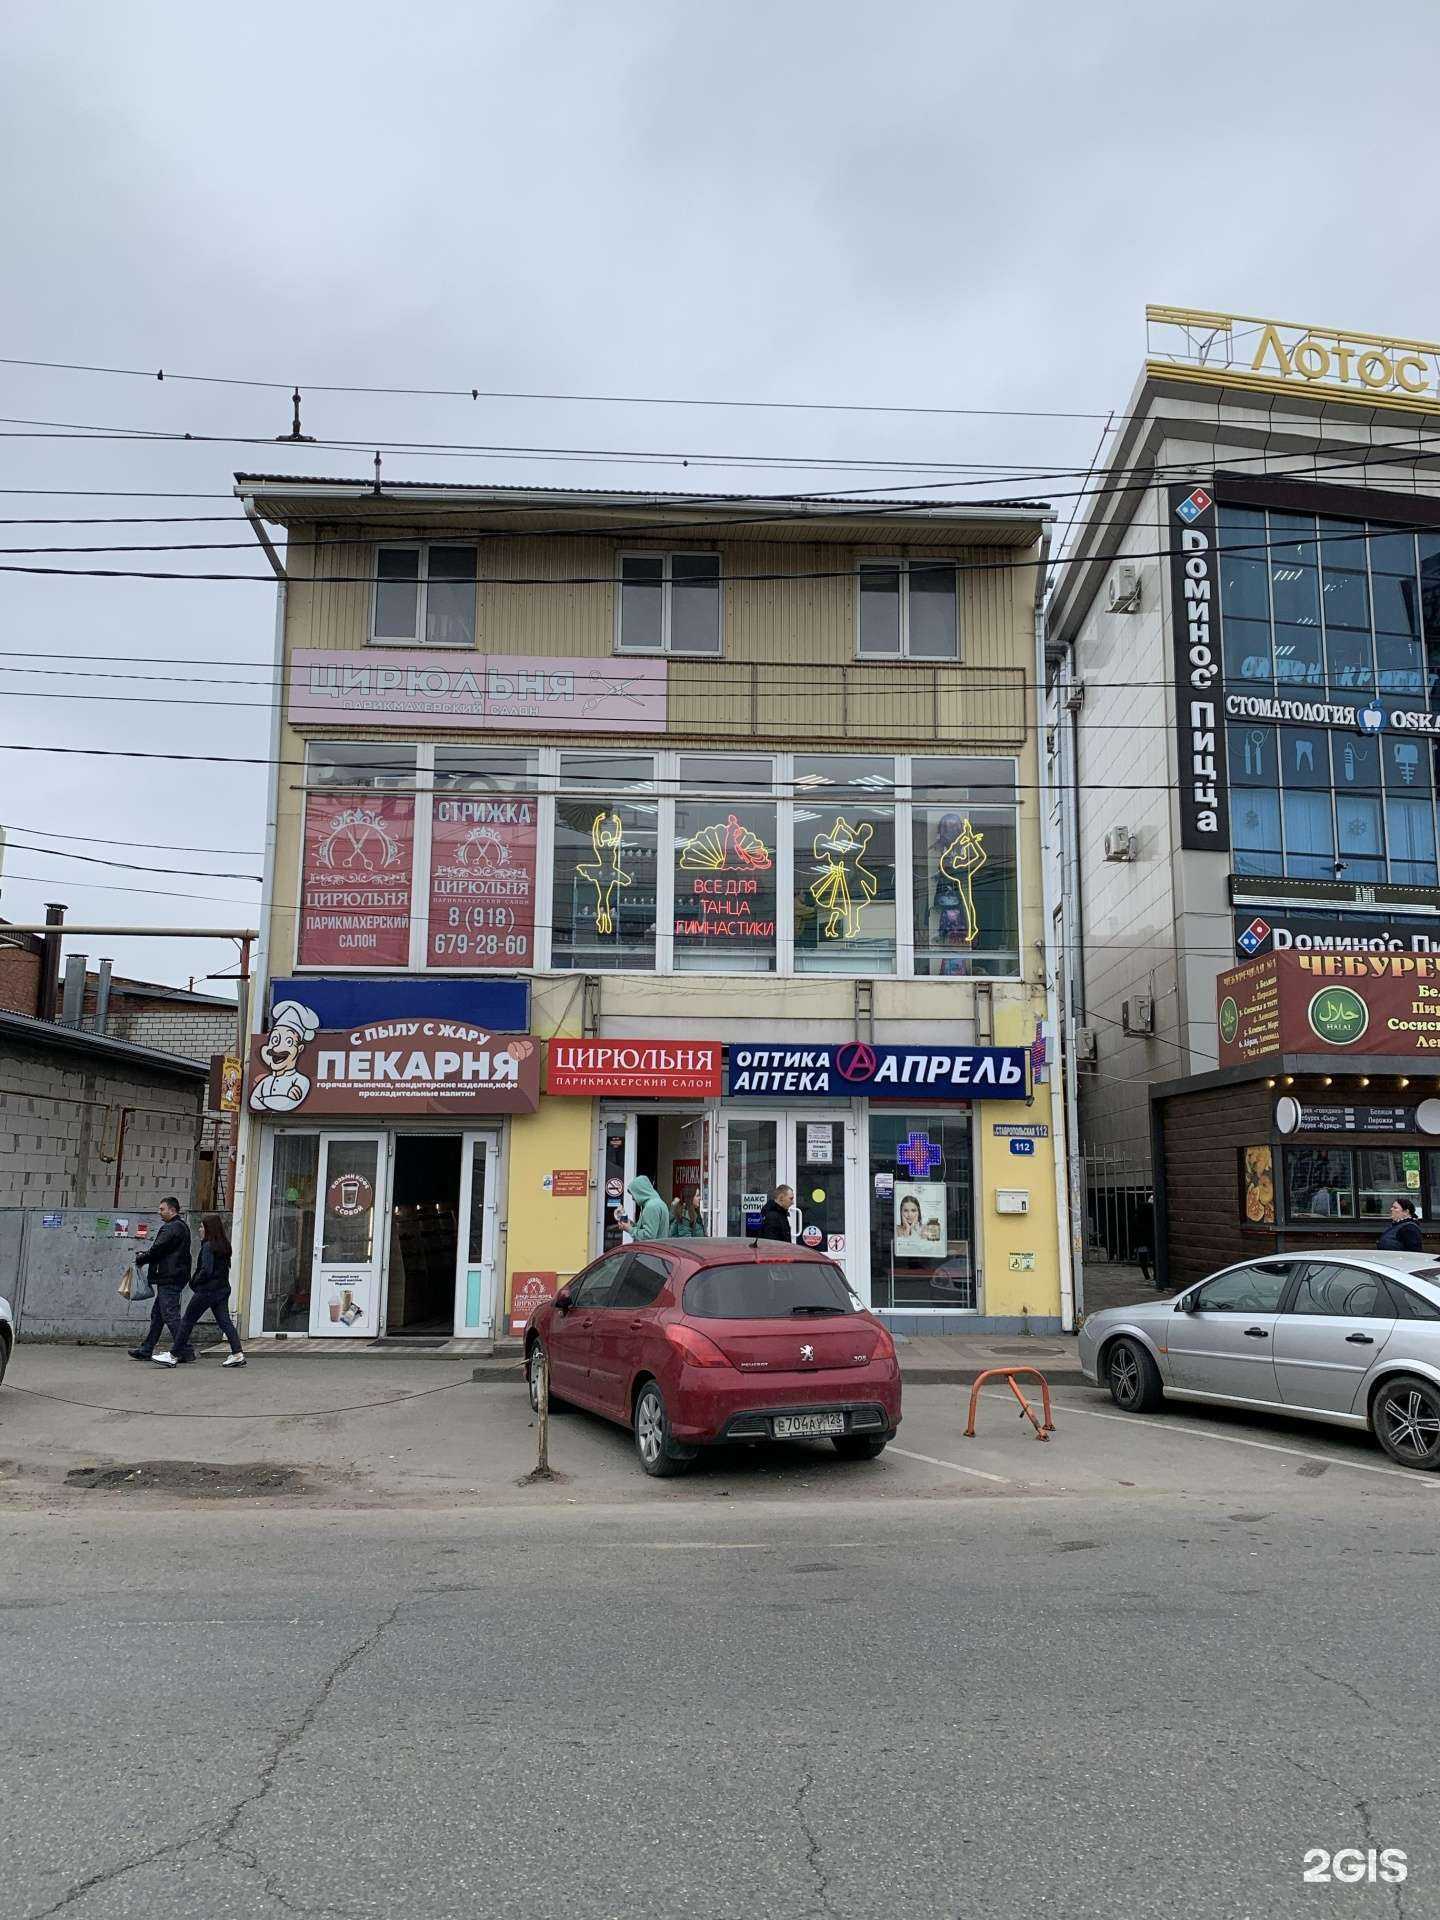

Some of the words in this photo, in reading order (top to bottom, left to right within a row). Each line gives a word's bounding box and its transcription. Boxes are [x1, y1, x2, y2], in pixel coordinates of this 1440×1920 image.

[309, 662, 574, 702] ЦИРЮЛЬНЯ
[343, 699, 482, 714] ПАРИКМАХЕРСКИЙ
[490, 703, 539, 716] САЛОН
[1226, 694, 1356, 725] СТОМАТОЛОГИЯ
[1189, 701, 1219, 833] Пицца
[438, 802, 531, 823] СТРИЖКА
[433, 880, 529, 896] ЦИРЮЛЬНЯ
[694, 879, 723, 894] ВСЕ
[725, 880, 757, 896] ДЛЯ
[306, 892, 408, 907] ЦИРЮЛЬНЯ
[700, 899, 751, 916] ТАНЦА
[306, 913, 409, 930] ПАРИКМАХЕРСКИЙ
[448, 907, 460, 925] 8
[466, 907, 515, 932] (918)
[674, 920, 774, 936] ГИМНАСТИКИ
[339, 934, 376, 948] САЛОН
[434, 934, 527, 955] 679-28-60
[1299, 955, 1440, 977] ЧЕБУРЕ
[1419, 985, 1440, 998] Бе
[350, 1034, 362, 1046] С
[365, 1023, 420, 1041] ПЫЛУ
[424, 1023, 435, 1036] С
[437, 1023, 490, 1046] ЖАРУ
[1416, 1035, 1440, 1048] Ле
[317, 1051, 519, 1080] ПЕКАРНЯ
[556, 1047, 713, 1071] ЦИРЮЛЬНЯ
[736, 1051, 829, 1069] ОПТИКА
[875, 1055, 1021, 1085] АПРЕЛЬ
[556, 1077, 669, 1088] ПАРИКМАХЕРСКИЙ
[672, 1078, 713, 1088] САЛОН
[734, 1072, 829, 1091] АПТЕКА
[358, 1090, 439, 1098] прохладительные
[1015, 1143, 1030, 1151] 112
[744, 1195, 765, 1203] МАКС
